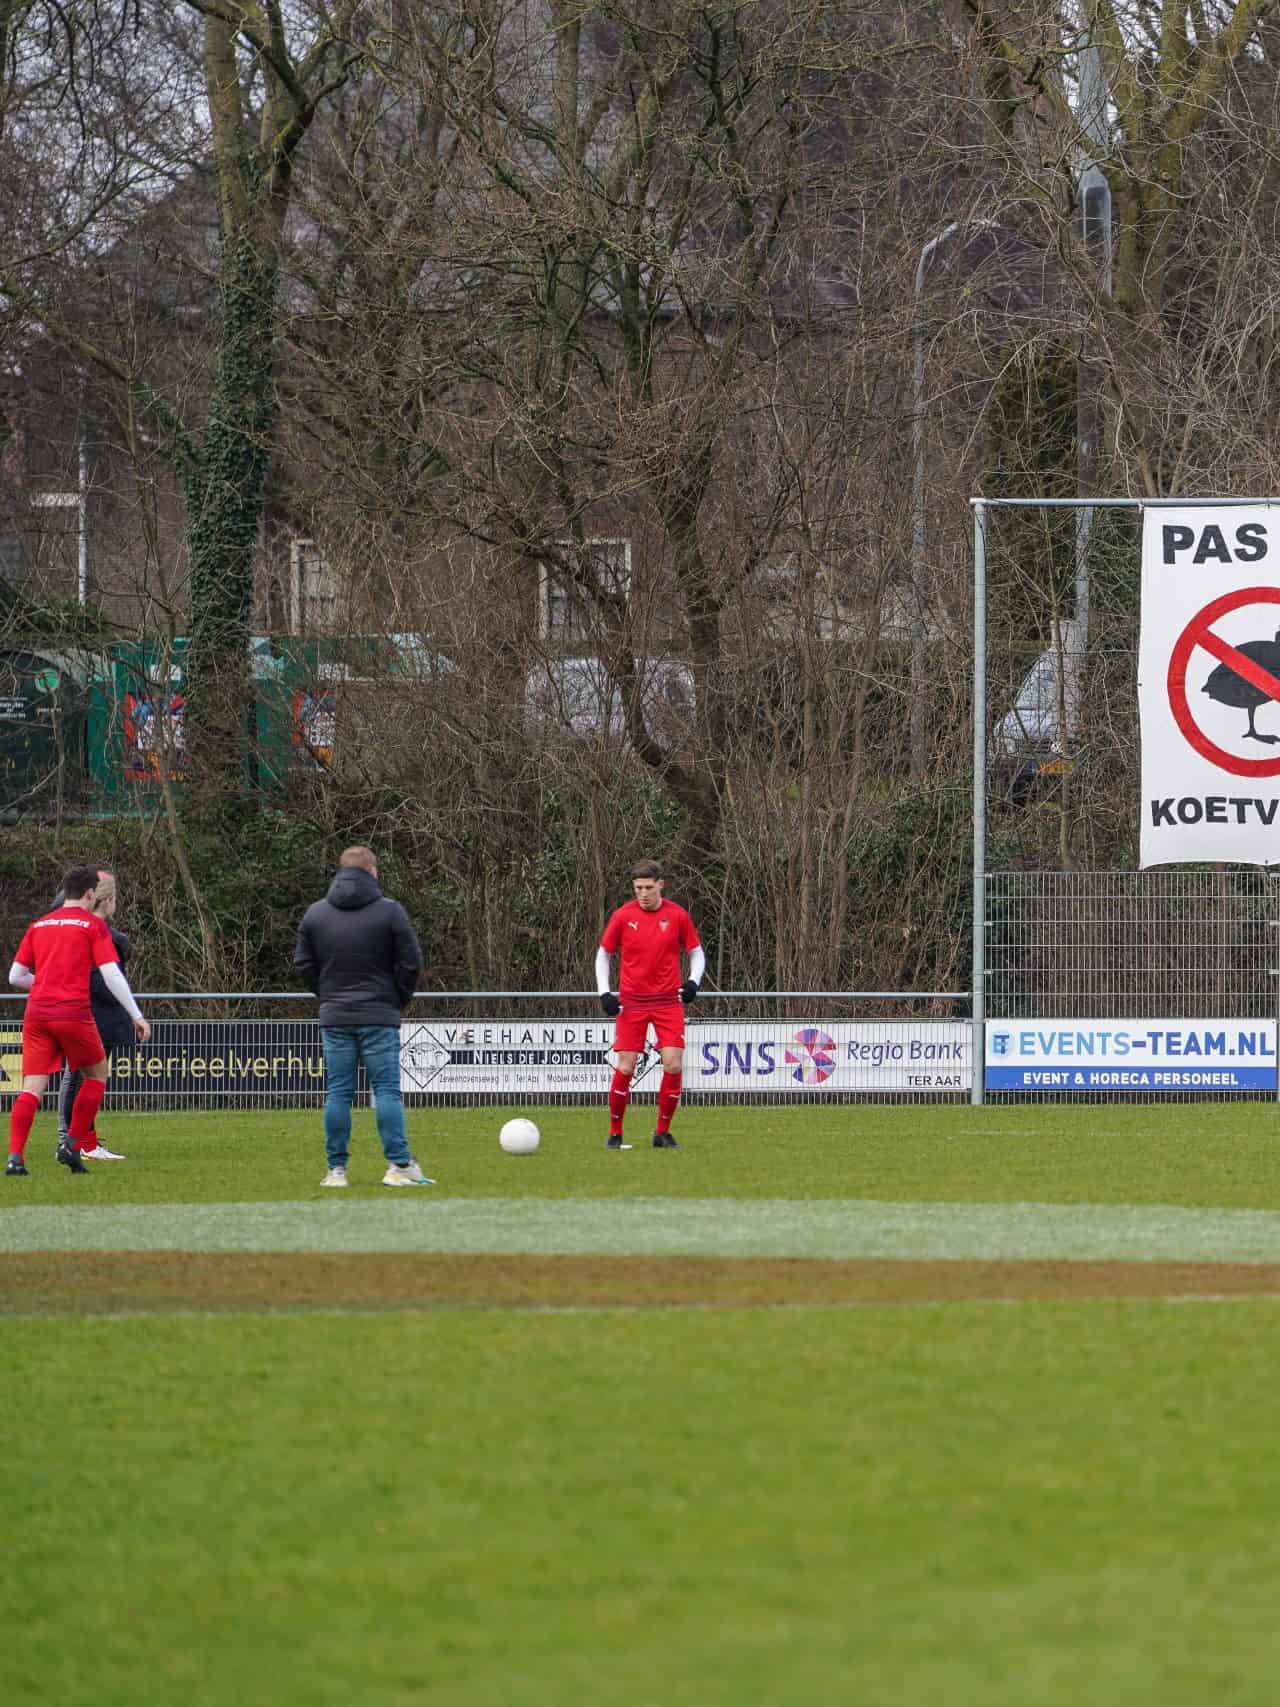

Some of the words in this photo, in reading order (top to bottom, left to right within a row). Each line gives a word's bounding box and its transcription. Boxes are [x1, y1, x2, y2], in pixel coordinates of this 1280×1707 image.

[1161, 523, 1269, 564] PAS
[445, 1029, 609, 1044] VEEHANDEL
[1019, 1031, 1275, 1056] EVENTS-TEAM.NL
[106, 1049, 324, 1078] aterieelverhu
[541, 1050, 582, 1065] JONG
[700, 1041, 776, 1076] SNS
[907, 1075, 931, 1086] TER
[935, 1075, 961, 1086] AAR
[1023, 1072, 1068, 1084] EVENT
[1074, 1072, 1085, 1084] &
[1090, 1072, 1149, 1085] HORECA
[1154, 1072, 1238, 1085] PERSONEEL
